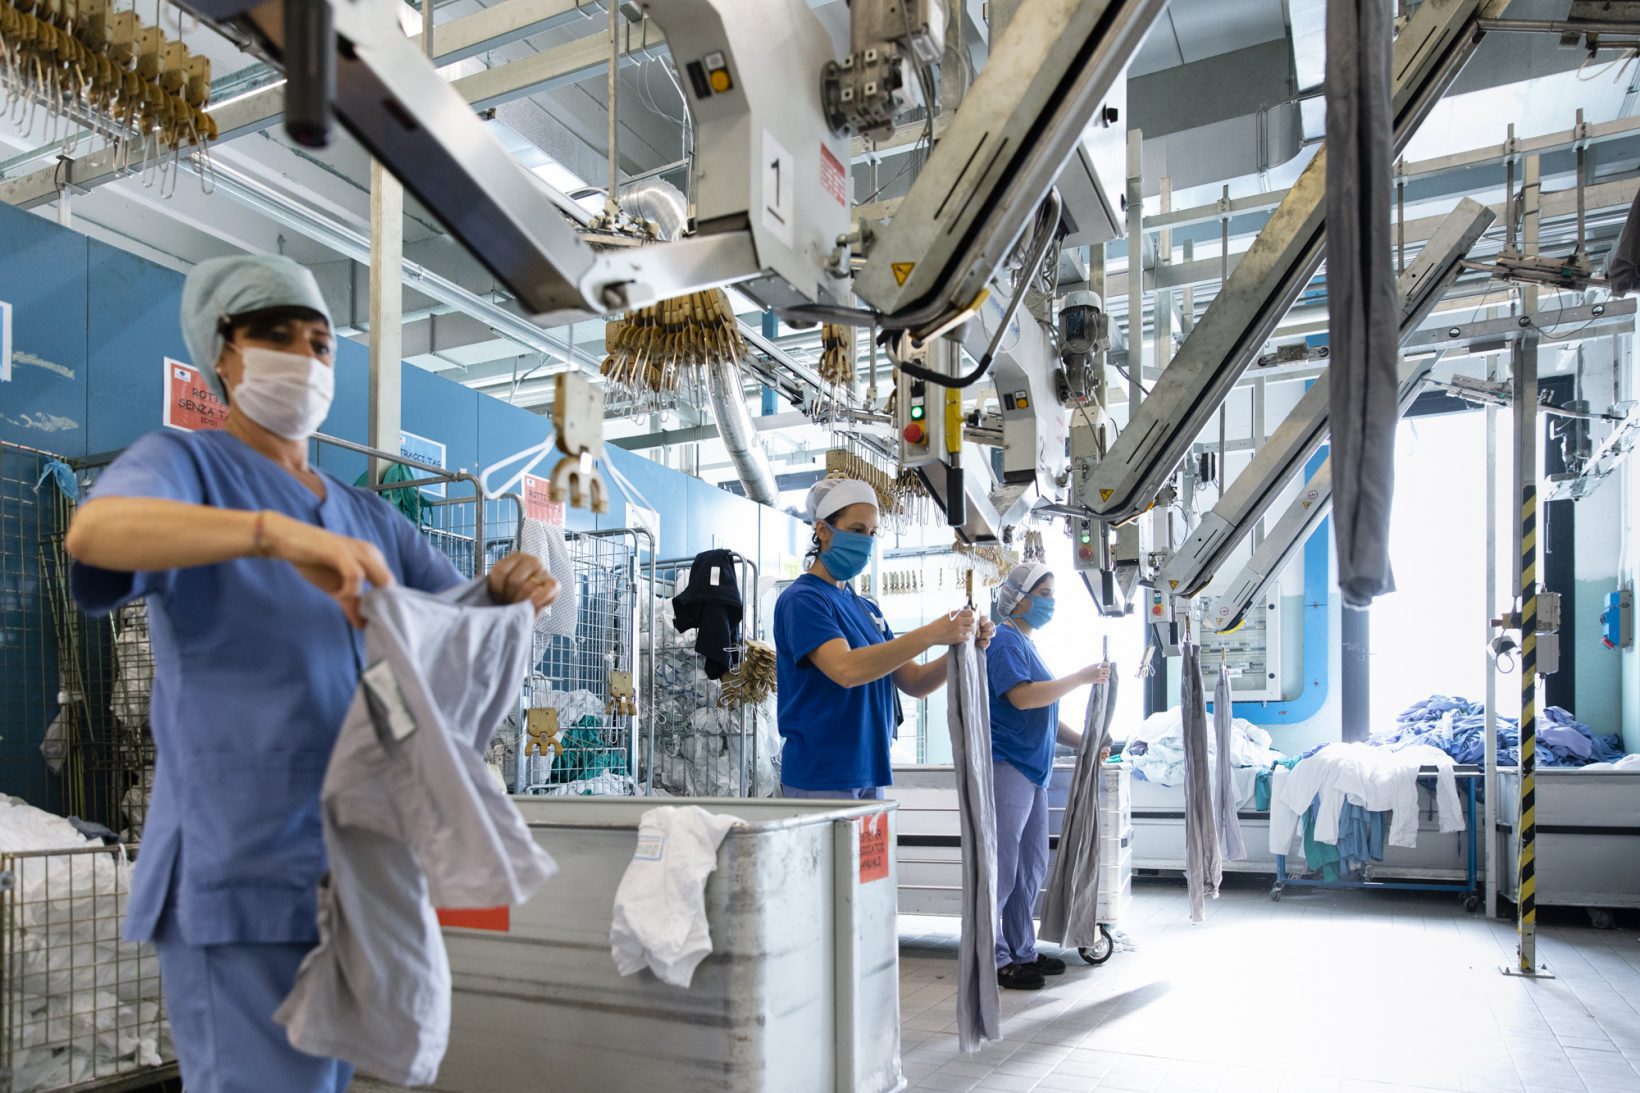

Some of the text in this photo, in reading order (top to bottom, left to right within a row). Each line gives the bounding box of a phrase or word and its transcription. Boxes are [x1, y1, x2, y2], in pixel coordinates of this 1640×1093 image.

[769, 157, 782, 213] 1
[192, 387, 218, 403] ROTT
[178, 398, 214, 417] SENZA
[400, 448, 442, 468] TRACCI TAG
